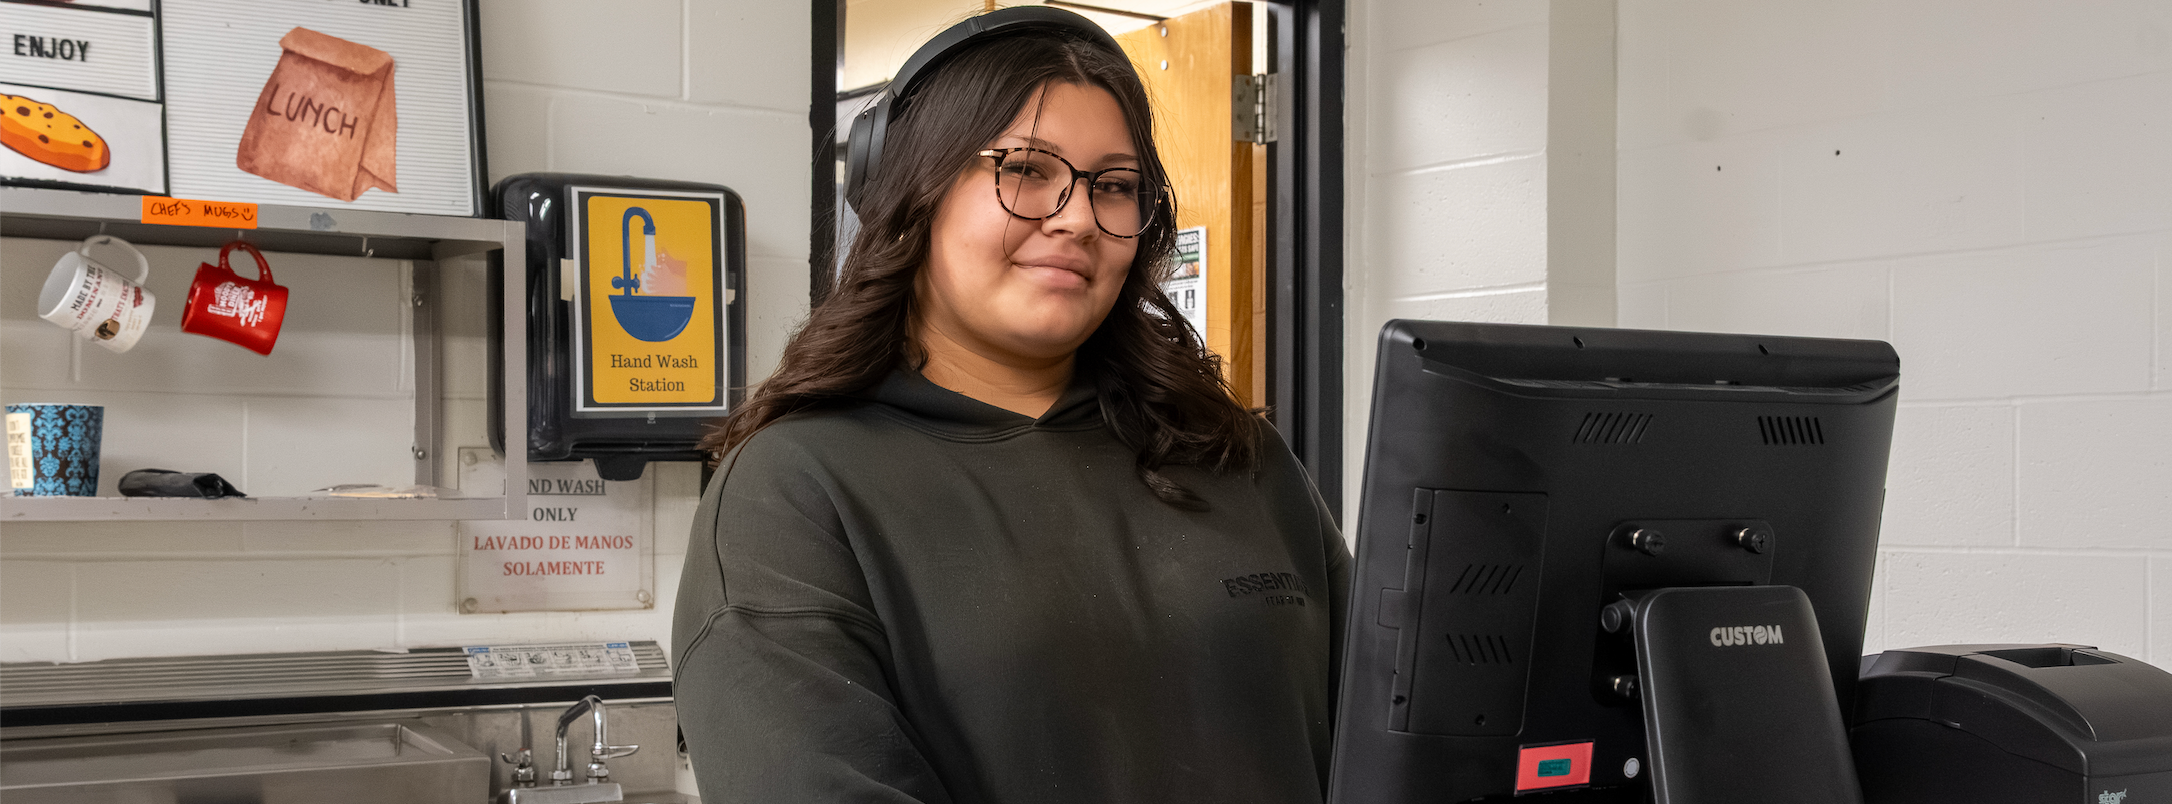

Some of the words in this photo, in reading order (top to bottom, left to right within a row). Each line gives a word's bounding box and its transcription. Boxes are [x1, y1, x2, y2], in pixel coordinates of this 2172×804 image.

[14, 34, 90, 62] ENJOY
[266, 83, 358, 140] LUNCH
[203, 204, 239, 219] MUGS
[70, 290, 88, 311] MADE
[610, 354, 652, 369] Hand
[656, 354, 699, 369] Wash
[629, 377, 685, 392] Station
[558, 479, 606, 494] WASH
[533, 507, 577, 521] ONLY
[474, 535, 544, 550] LAVADO
[549, 535, 571, 550] DE
[575, 535, 634, 550] MANOS
[503, 561, 605, 576] SOLAMENTE
[1710, 625, 1783, 647] CUSTOM
